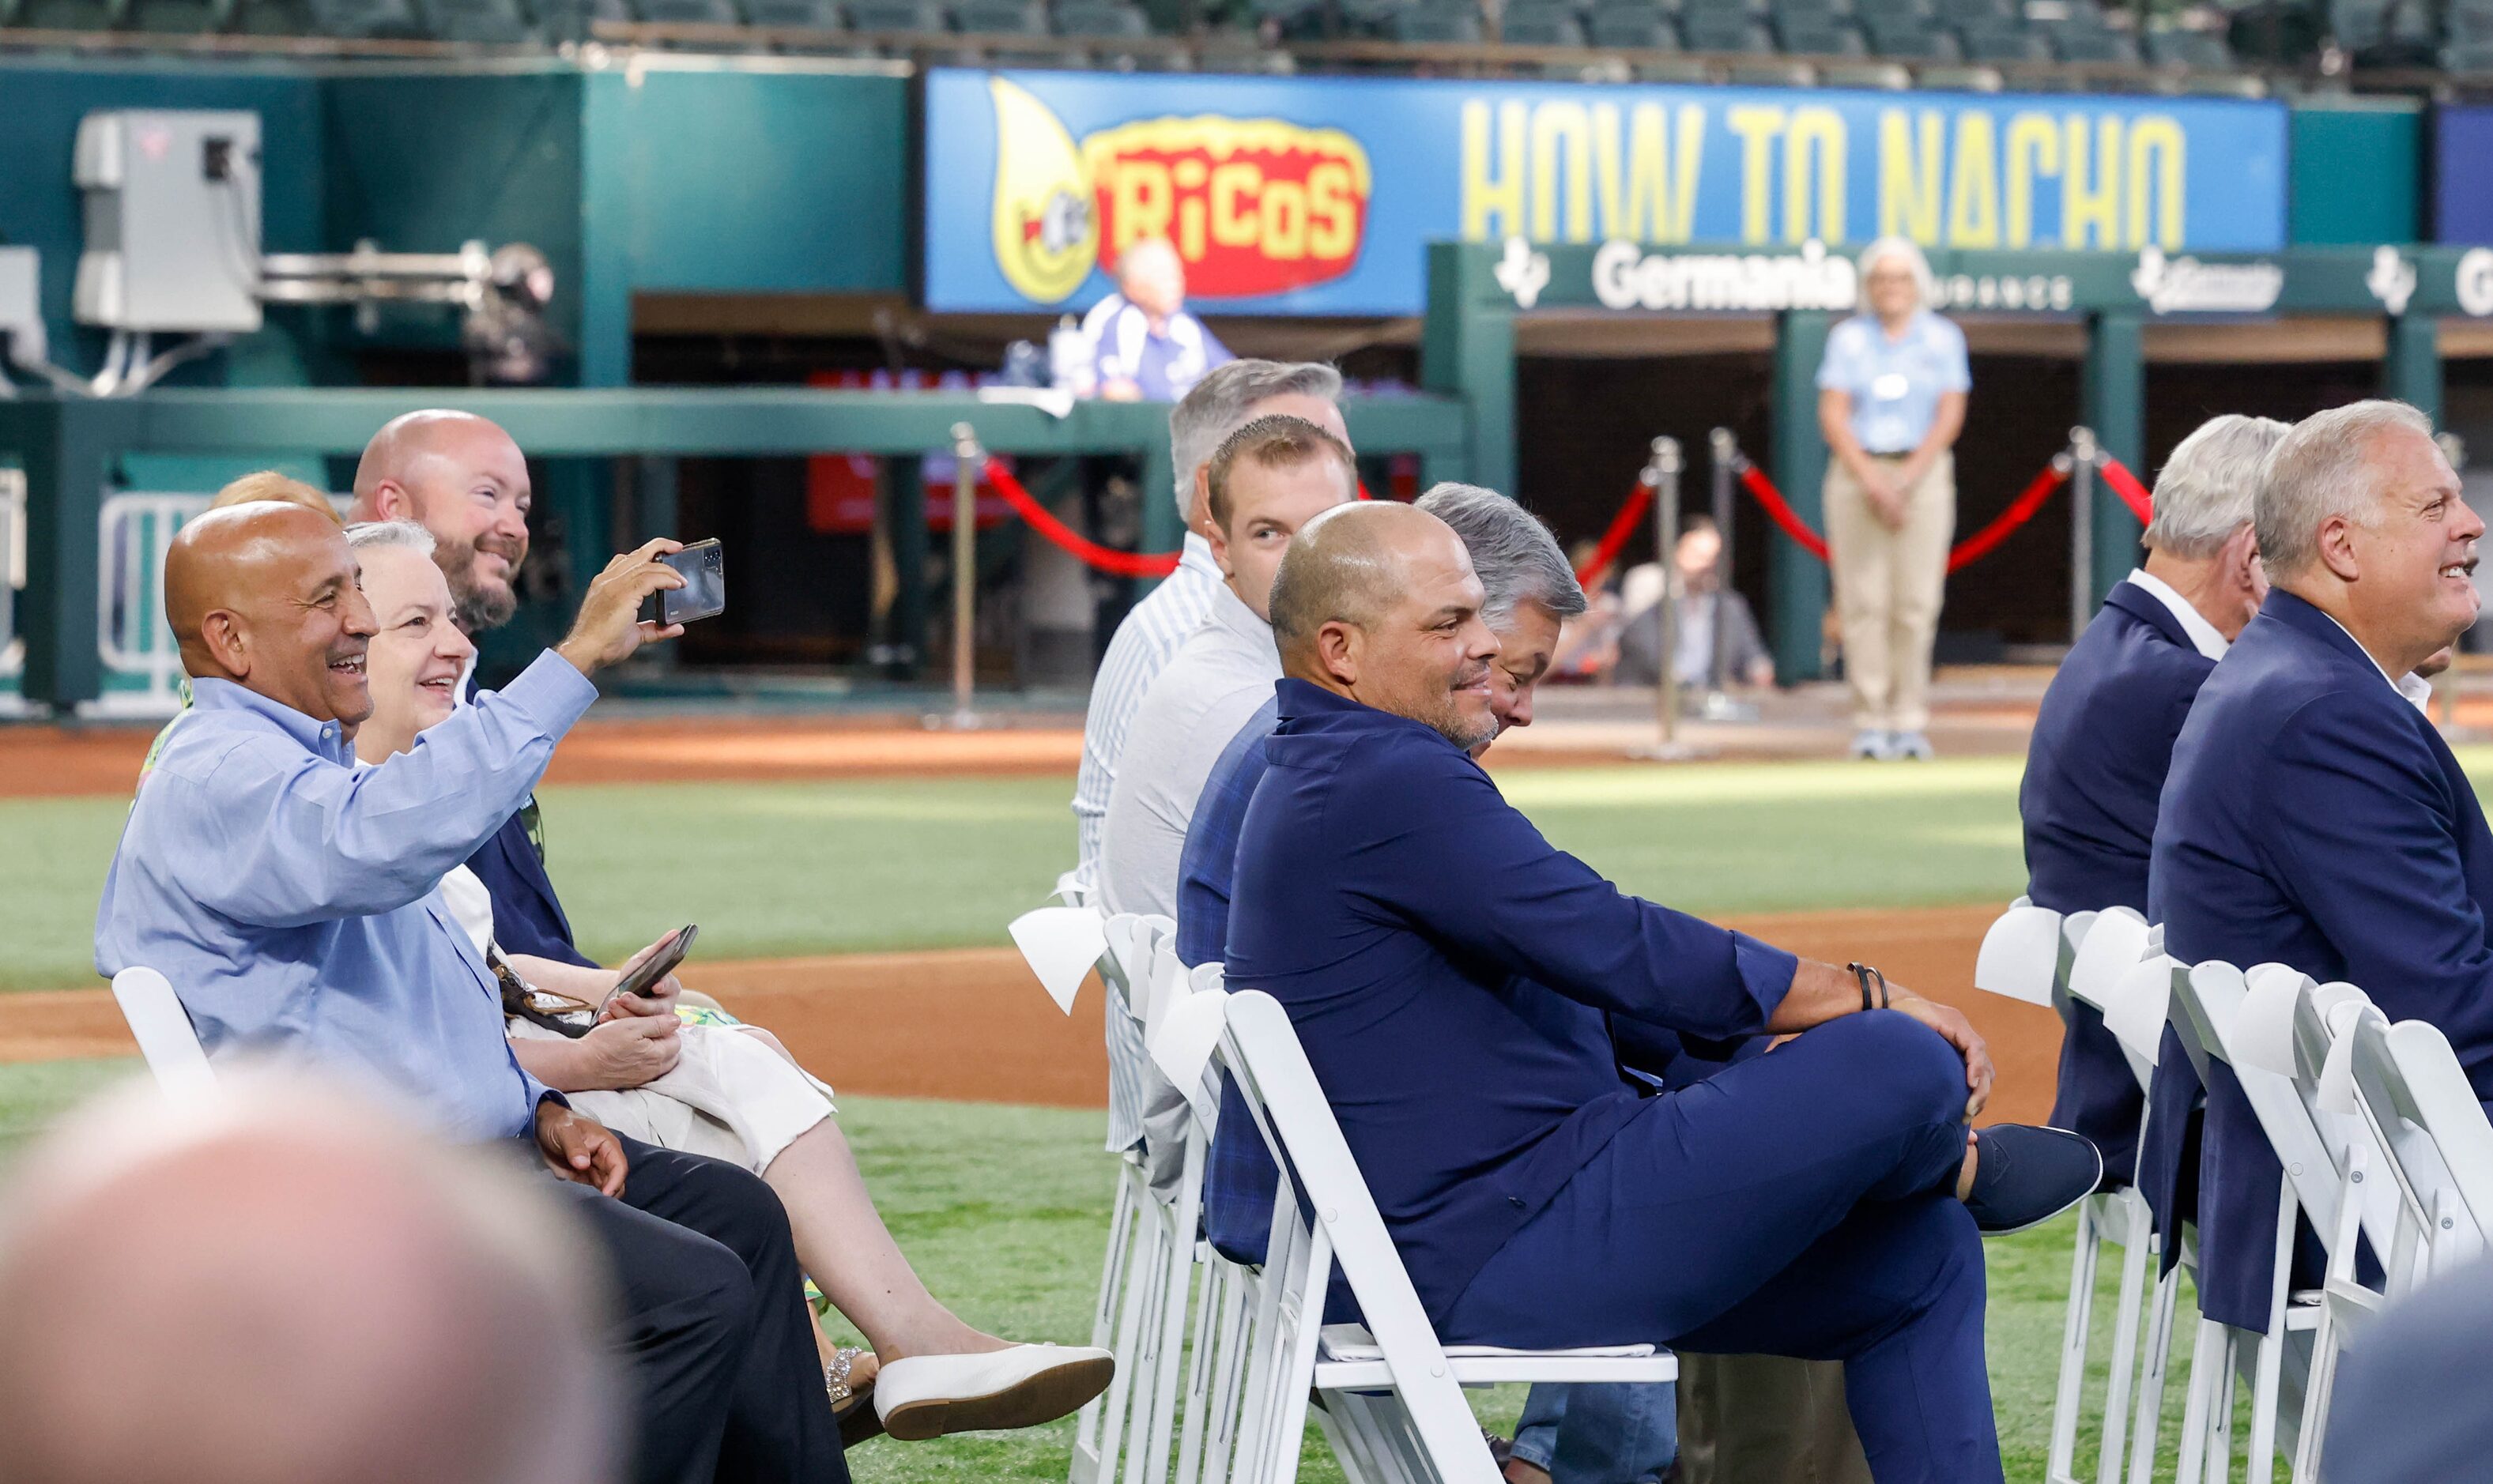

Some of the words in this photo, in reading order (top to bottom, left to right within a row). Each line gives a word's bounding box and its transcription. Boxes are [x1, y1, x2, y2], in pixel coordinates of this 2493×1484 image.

[1461, 100, 1706, 245] HOW
[1726, 104, 1849, 247] TO
[1878, 107, 2187, 252] NACHO
[1592, 238, 1857, 311] Germania
